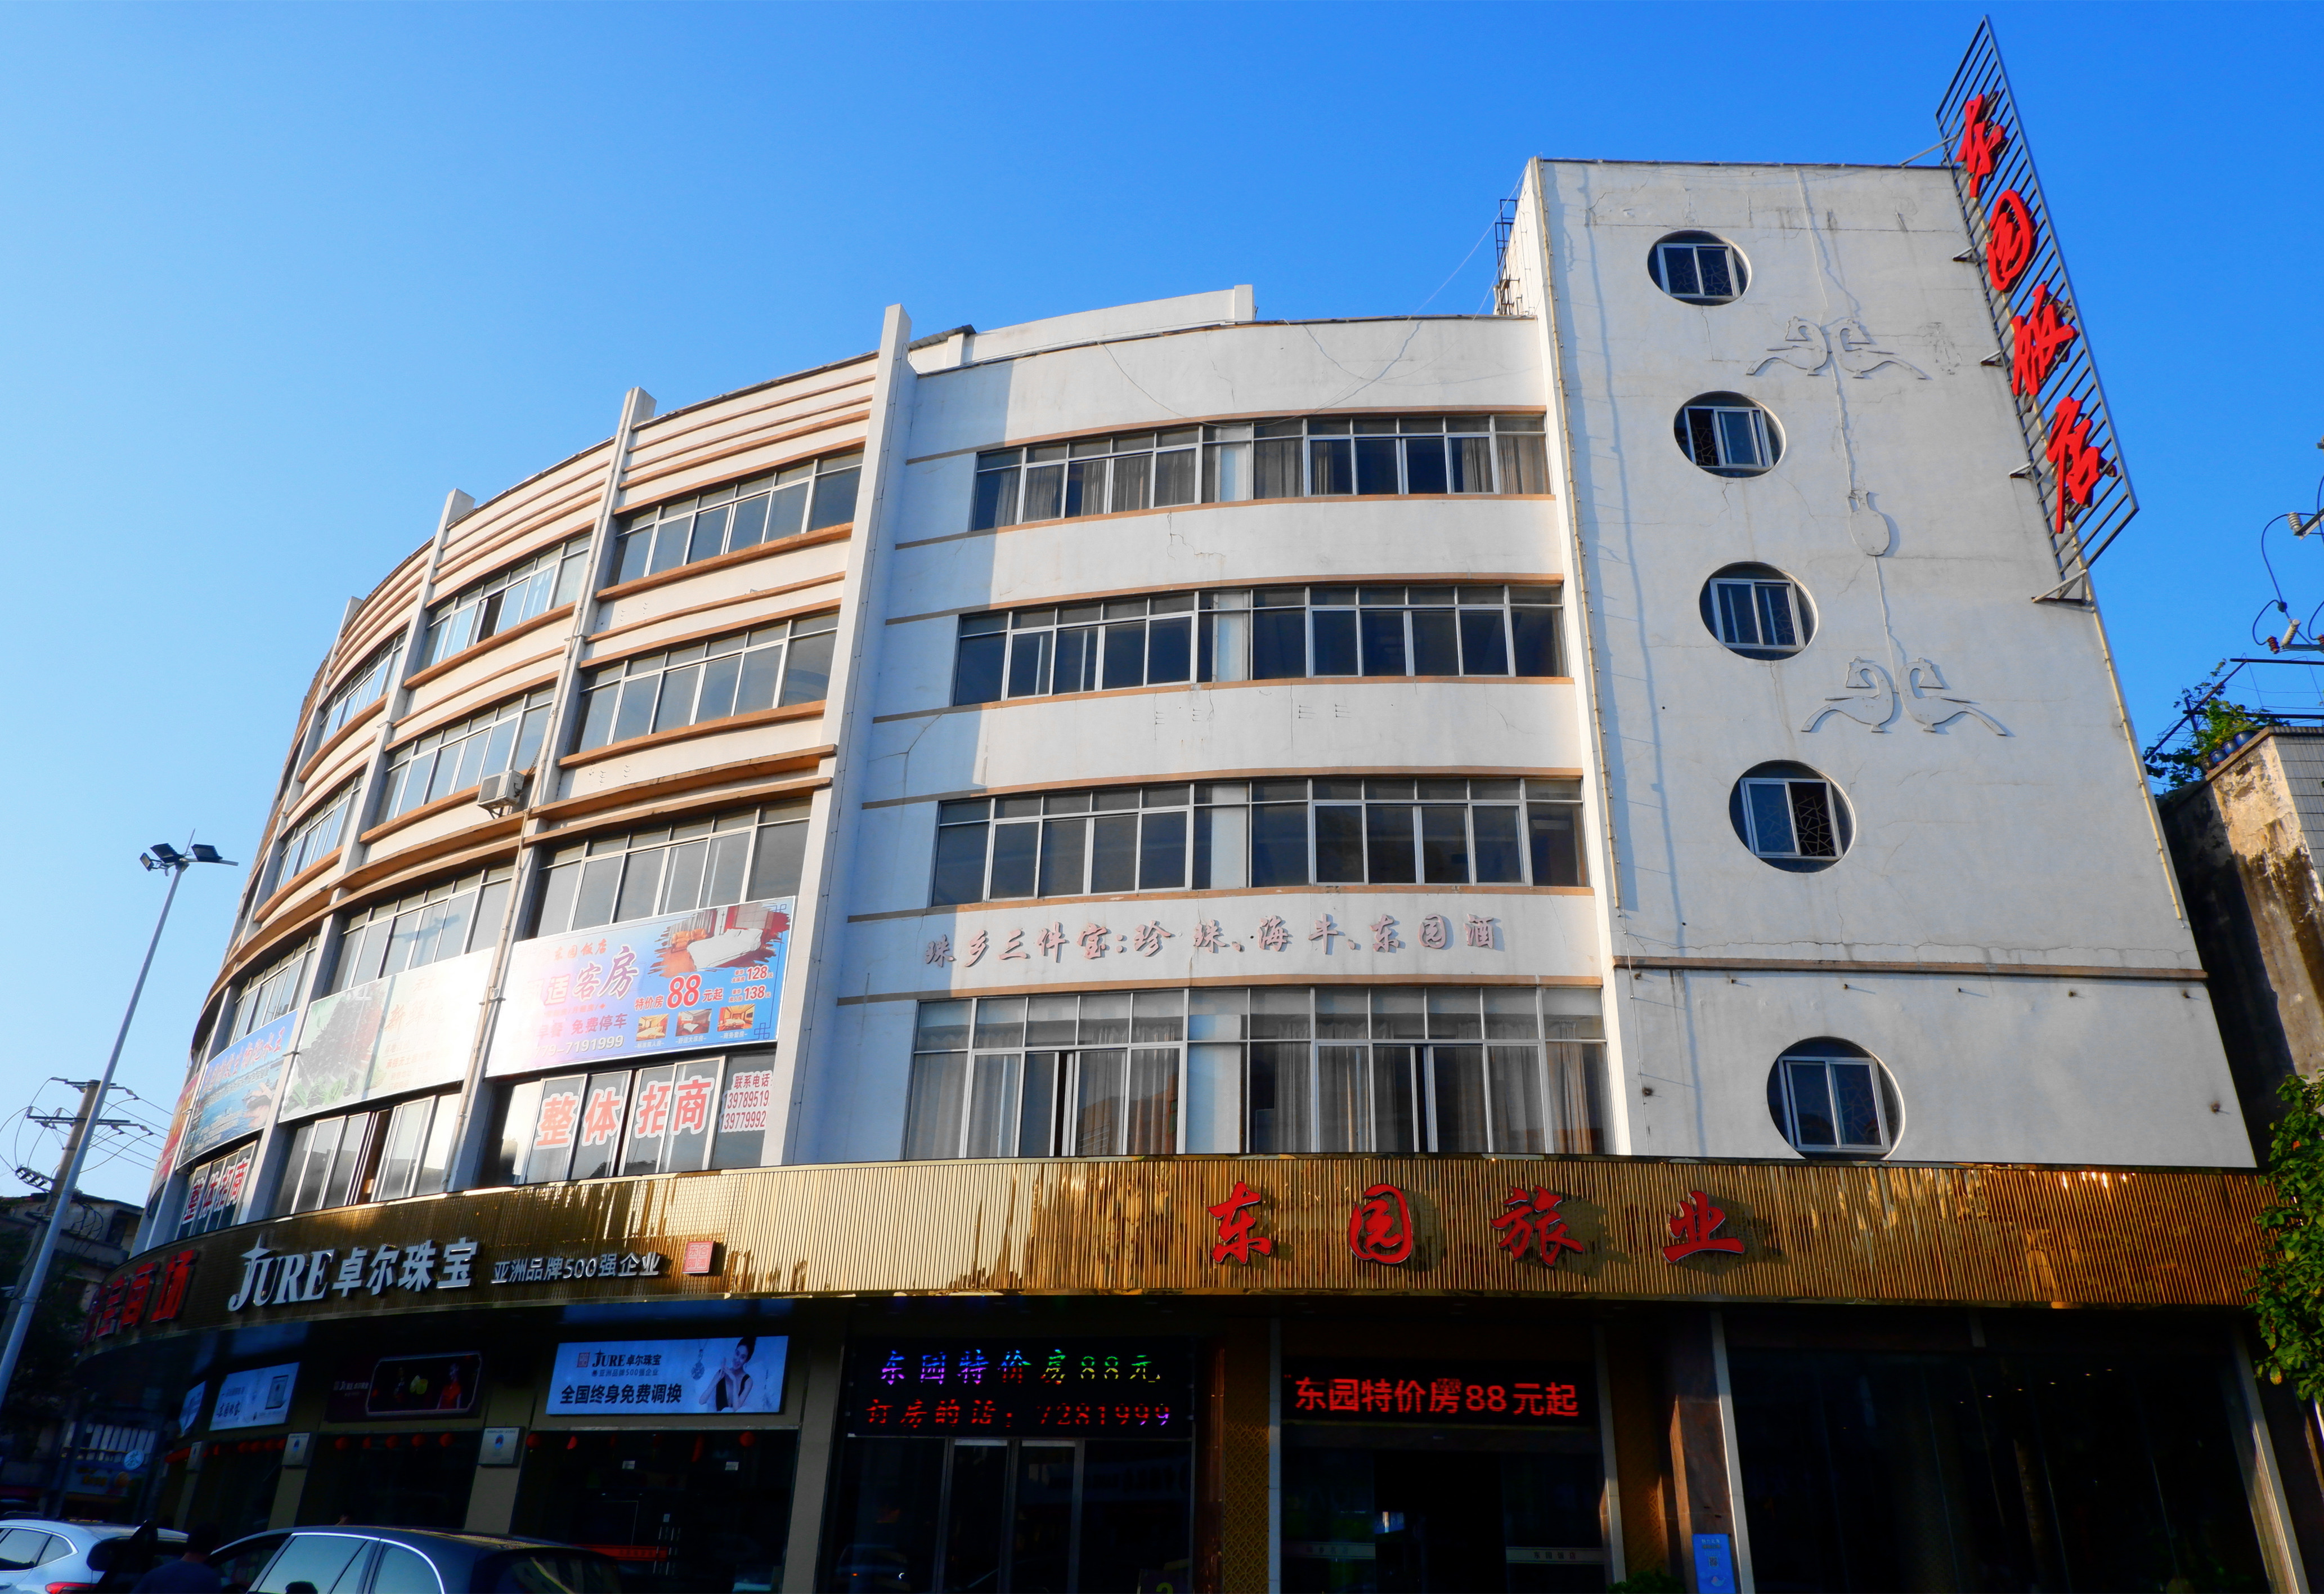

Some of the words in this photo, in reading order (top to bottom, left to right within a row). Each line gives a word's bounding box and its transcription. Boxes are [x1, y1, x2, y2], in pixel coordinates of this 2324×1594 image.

[554, 938, 607, 960] 东园饭店
[571, 1013, 628, 1035] 免费停车
[724, 1090, 769, 1110] 139789519
[537, 1078, 712, 1147] 整体招商
[1207, 1181, 1746, 1267] 东园旅业
[228, 1237, 336, 1312] JURE
[332, 1237, 479, 1298] 卓尔珠宝
[491, 1251, 661, 1284] 亚洲品牌500强企业
[592, 1349, 626, 1367] JURE
[626, 1353, 662, 1367] 卓尔珠宝
[560, 1383, 683, 1405] 全国终身免费调换
